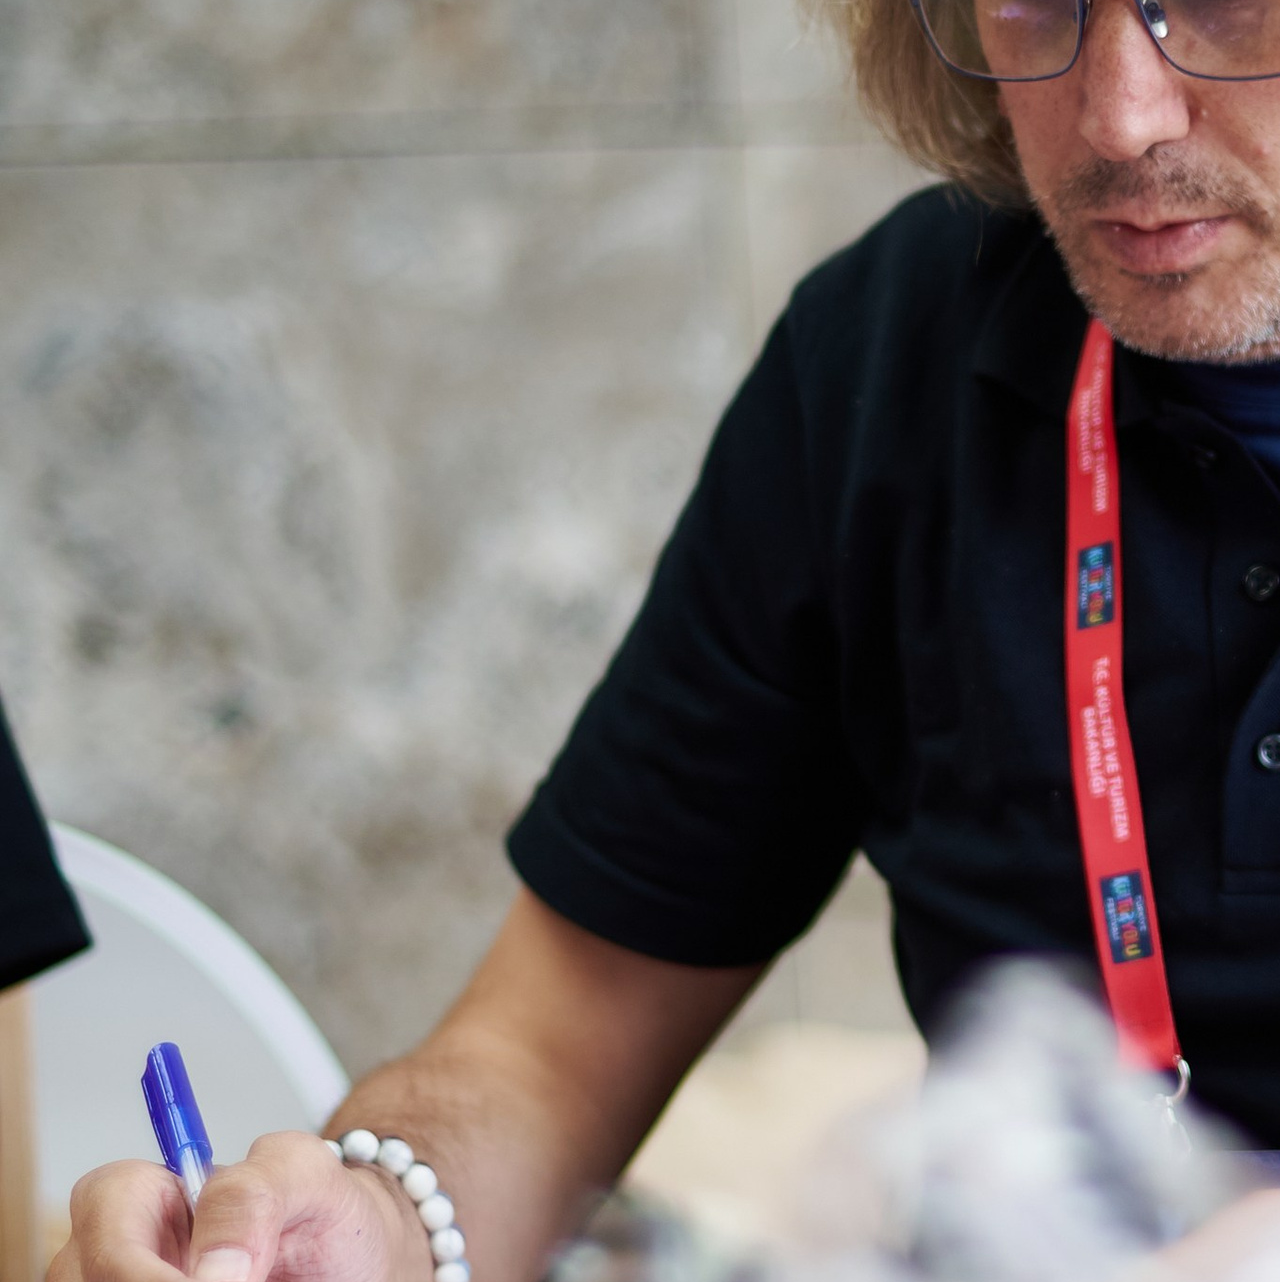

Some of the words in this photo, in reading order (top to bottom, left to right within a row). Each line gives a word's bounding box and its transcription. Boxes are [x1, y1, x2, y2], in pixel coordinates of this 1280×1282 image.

[1096, 657, 1108, 684] T.C.
[1097, 686, 1115, 748] KÜLTÜR
[1083, 707, 1106, 794] BAKANLIĞI
[1106, 753, 1118, 773] VE
[1109, 777, 1129, 838] TURİZM
